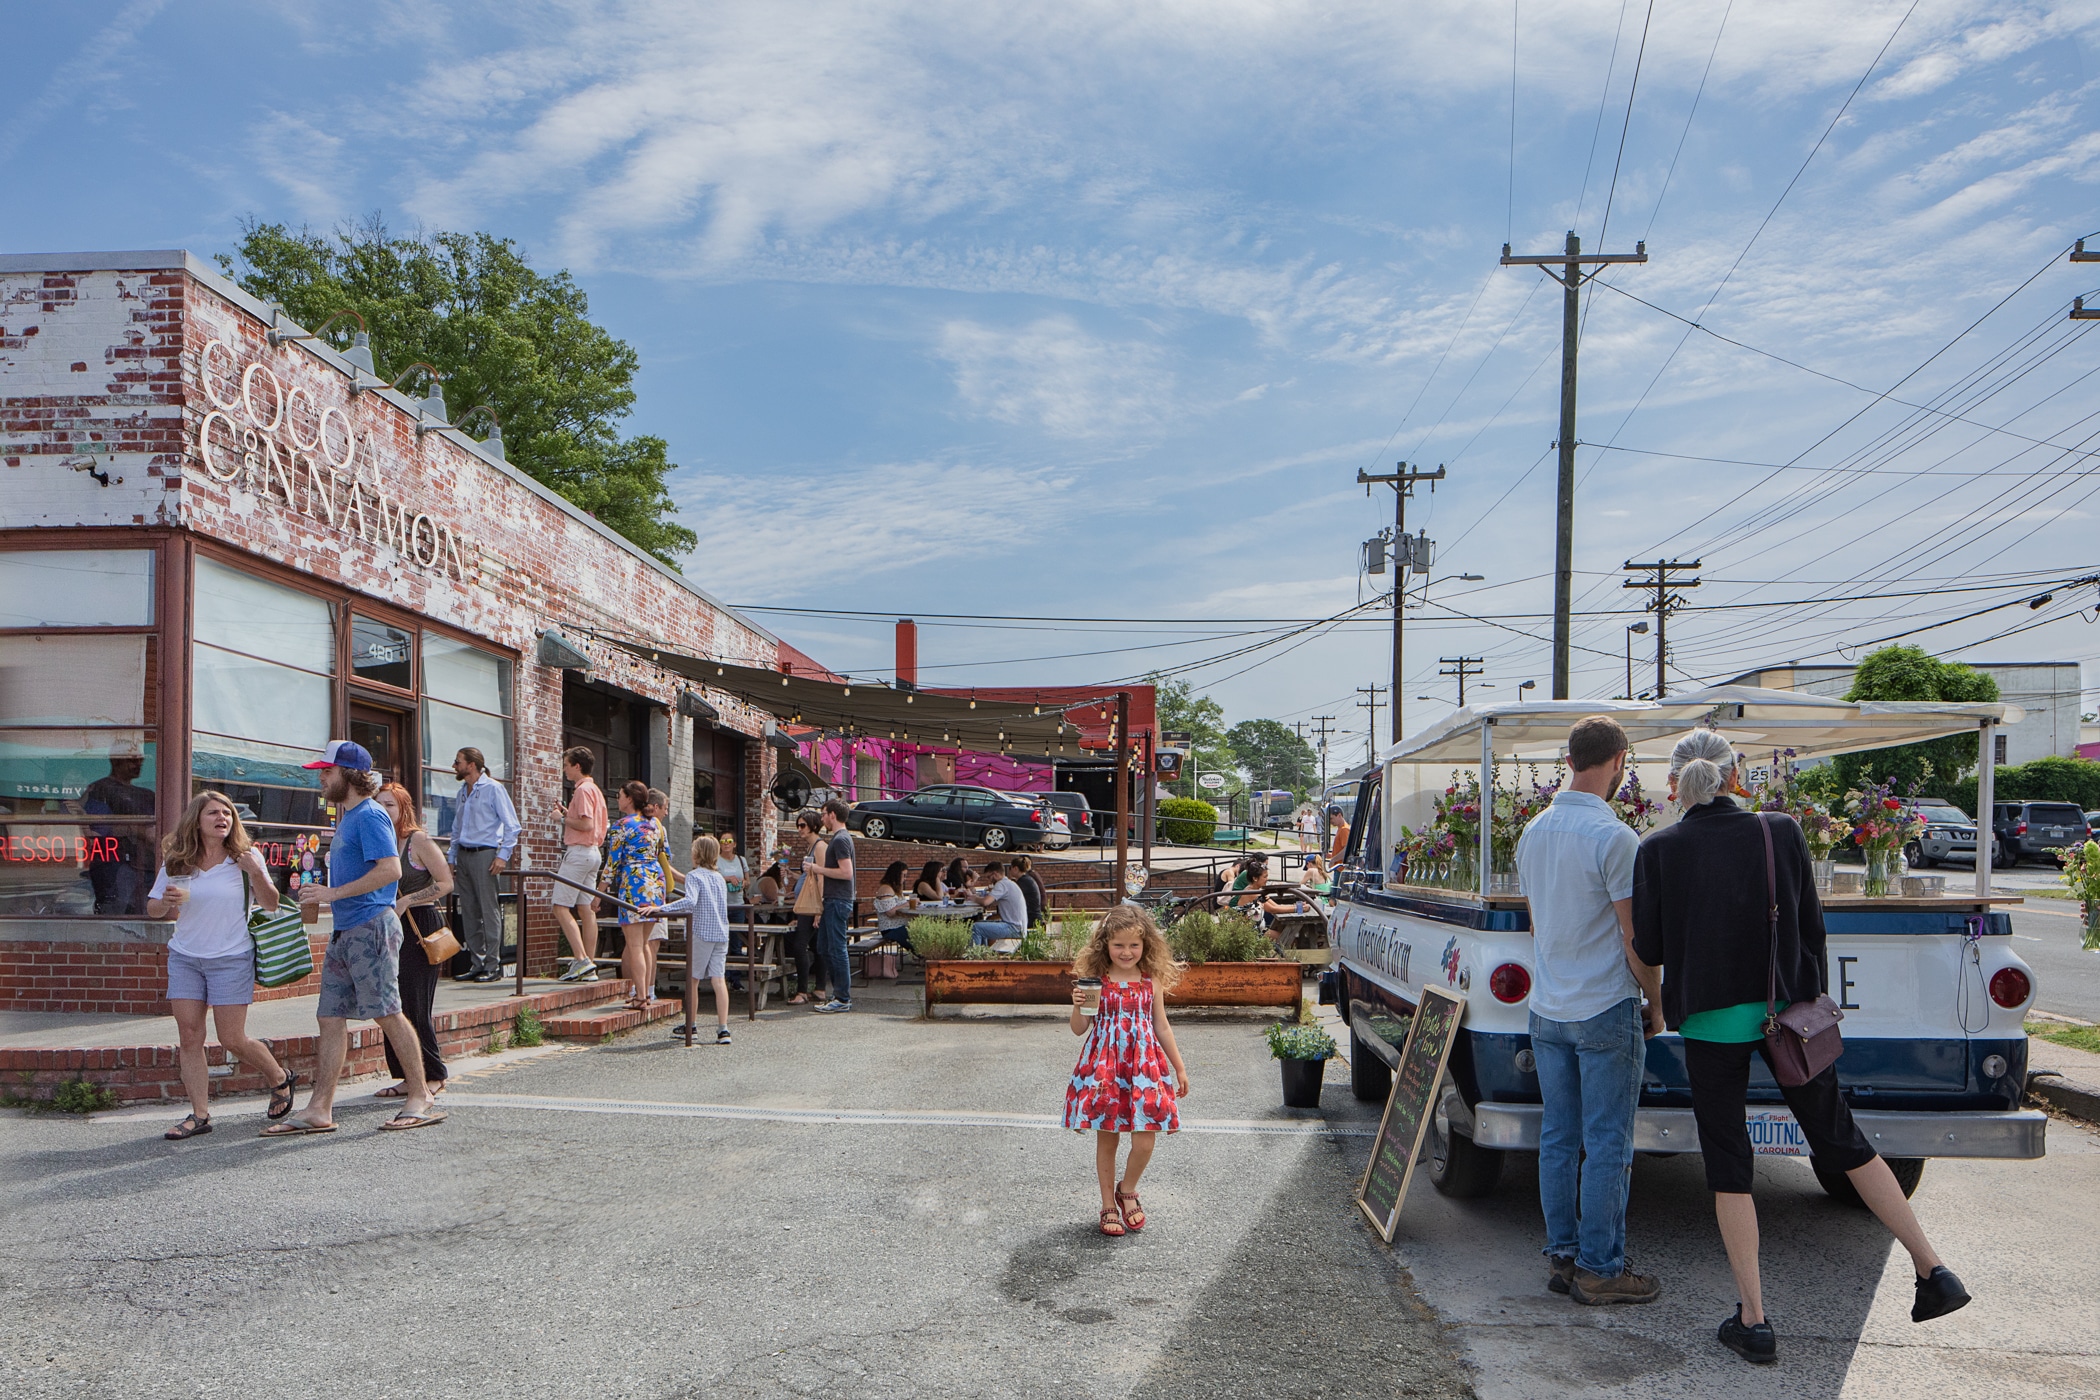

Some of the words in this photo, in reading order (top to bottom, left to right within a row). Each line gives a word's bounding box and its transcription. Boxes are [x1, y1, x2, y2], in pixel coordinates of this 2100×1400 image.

[202, 340, 382, 486] COCOA
[200, 411, 465, 580] CINNAMON
[368, 643, 393, 662] 420
[1750, 770, 1769, 781] 25
[74, 836, 120, 862] BAR
[1356, 917, 1387, 972] Fireside
[1387, 927, 1412, 983] Farm
[1769, 1114, 1789, 1122] Flight
[1758, 1146, 1801, 1155] CAROLINA
